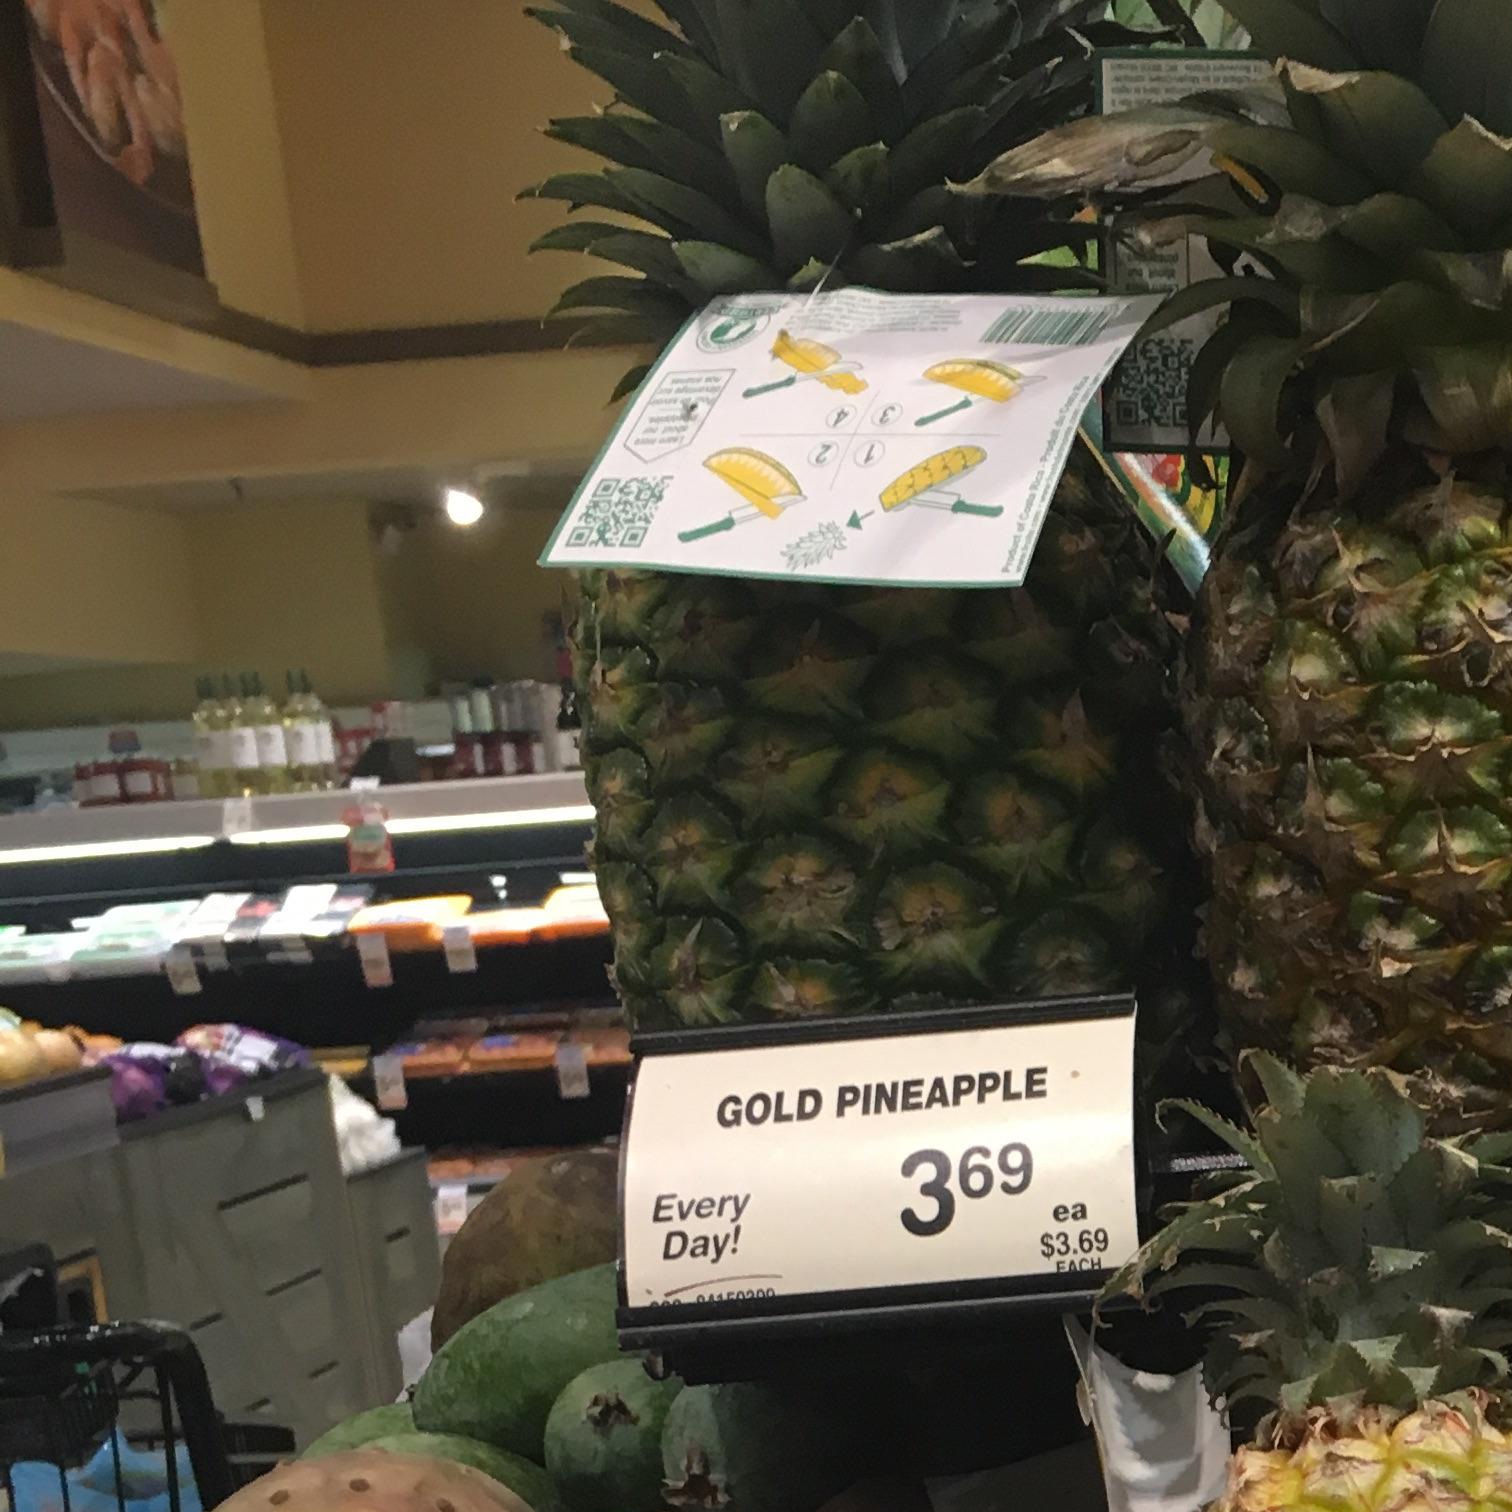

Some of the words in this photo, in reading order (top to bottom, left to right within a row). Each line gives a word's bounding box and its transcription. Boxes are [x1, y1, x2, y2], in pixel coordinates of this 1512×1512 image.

[833, 408, 849, 427] 4
[879, 405, 896, 425] 3
[815, 442, 832, 464] 2
[863, 443, 875, 465] 1
[717, 1088, 823, 1128] GOLD
[836, 1067, 1048, 1118] PINEAPPLE
[652, 1193, 751, 1224] Every
[1053, 1202, 1088, 1222] ea
[663, 1225, 742, 1264] Day!
[1040, 1227, 1109, 1260] $3.69
[1056, 1257, 1102, 1273] EACH
